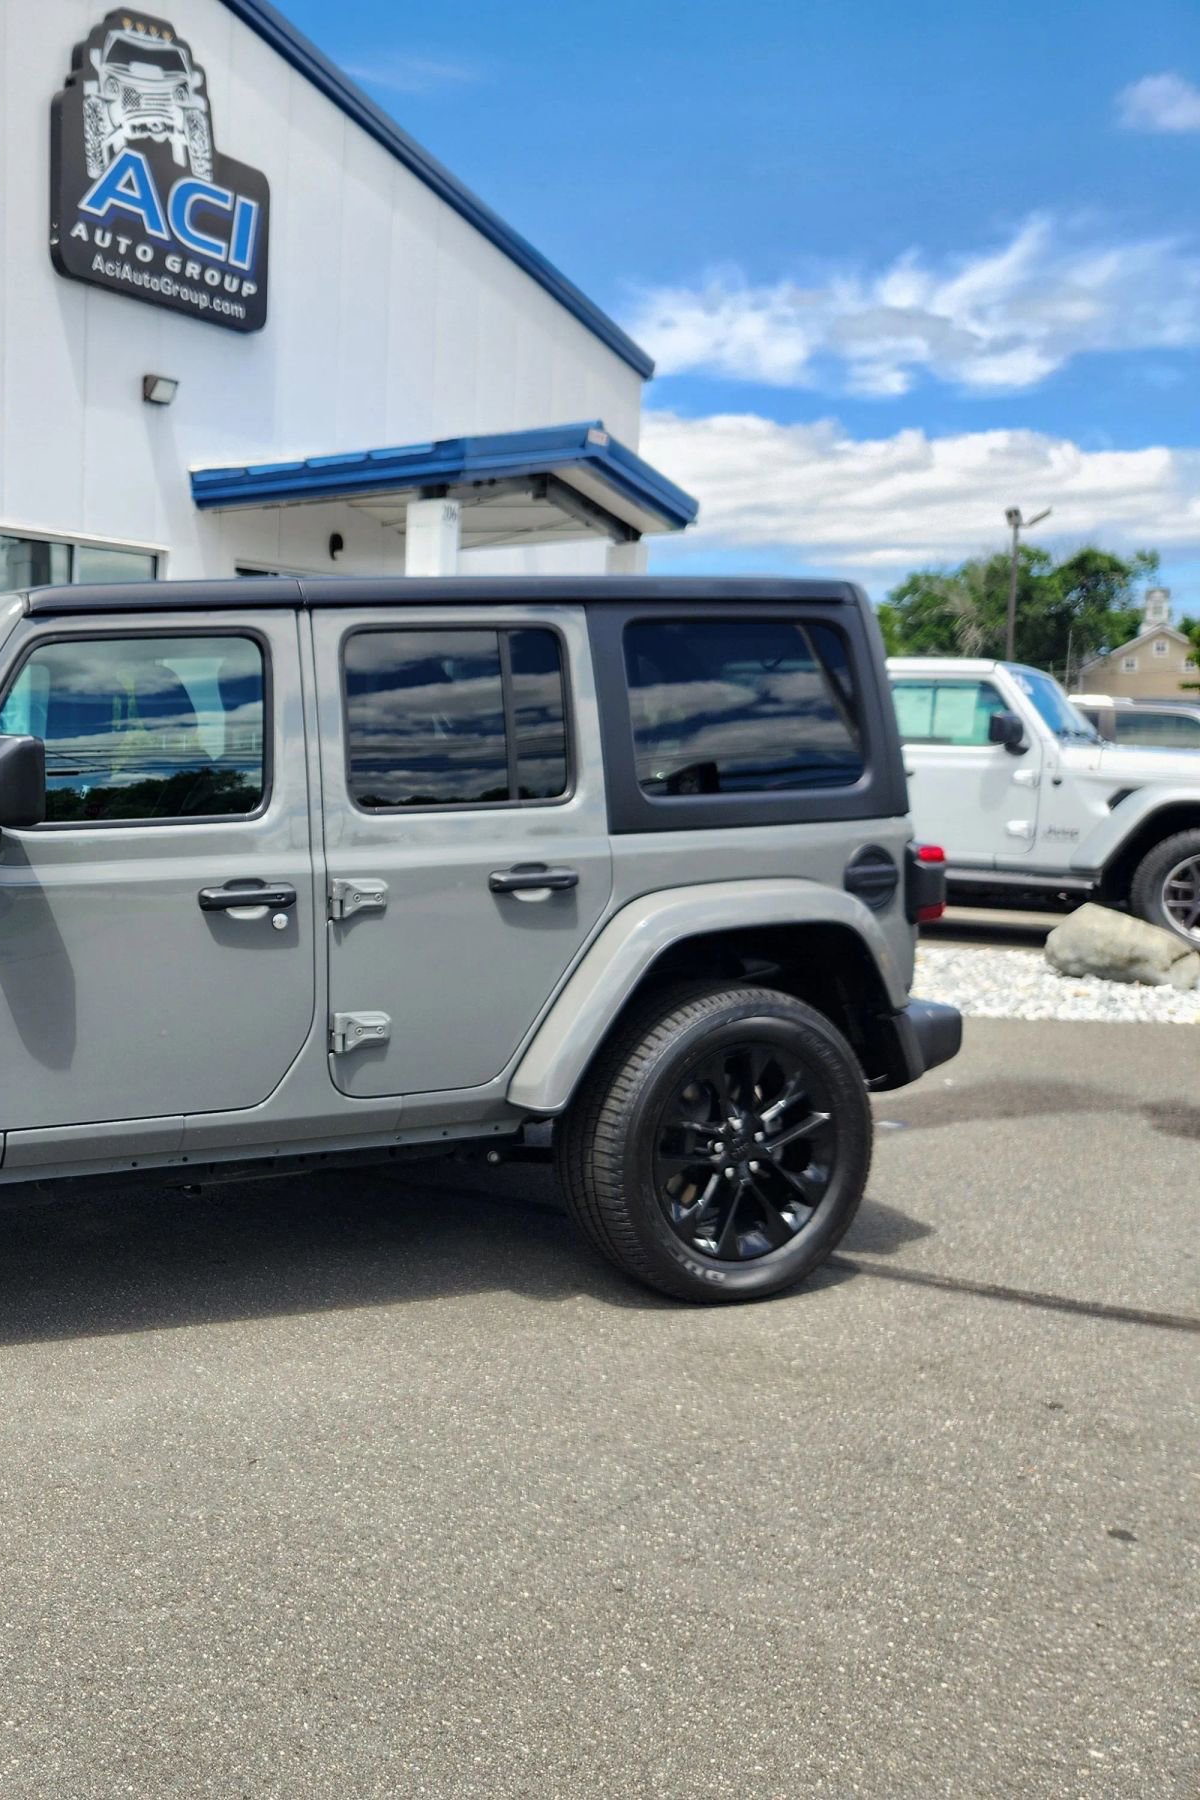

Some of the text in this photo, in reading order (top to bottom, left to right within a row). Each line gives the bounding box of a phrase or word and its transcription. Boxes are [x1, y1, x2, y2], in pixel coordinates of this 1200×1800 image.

[77, 147, 259, 271] ACI
[70, 221, 258, 298] AUTO GROUP
[91, 254, 247, 320] AciAutoGroup.com
